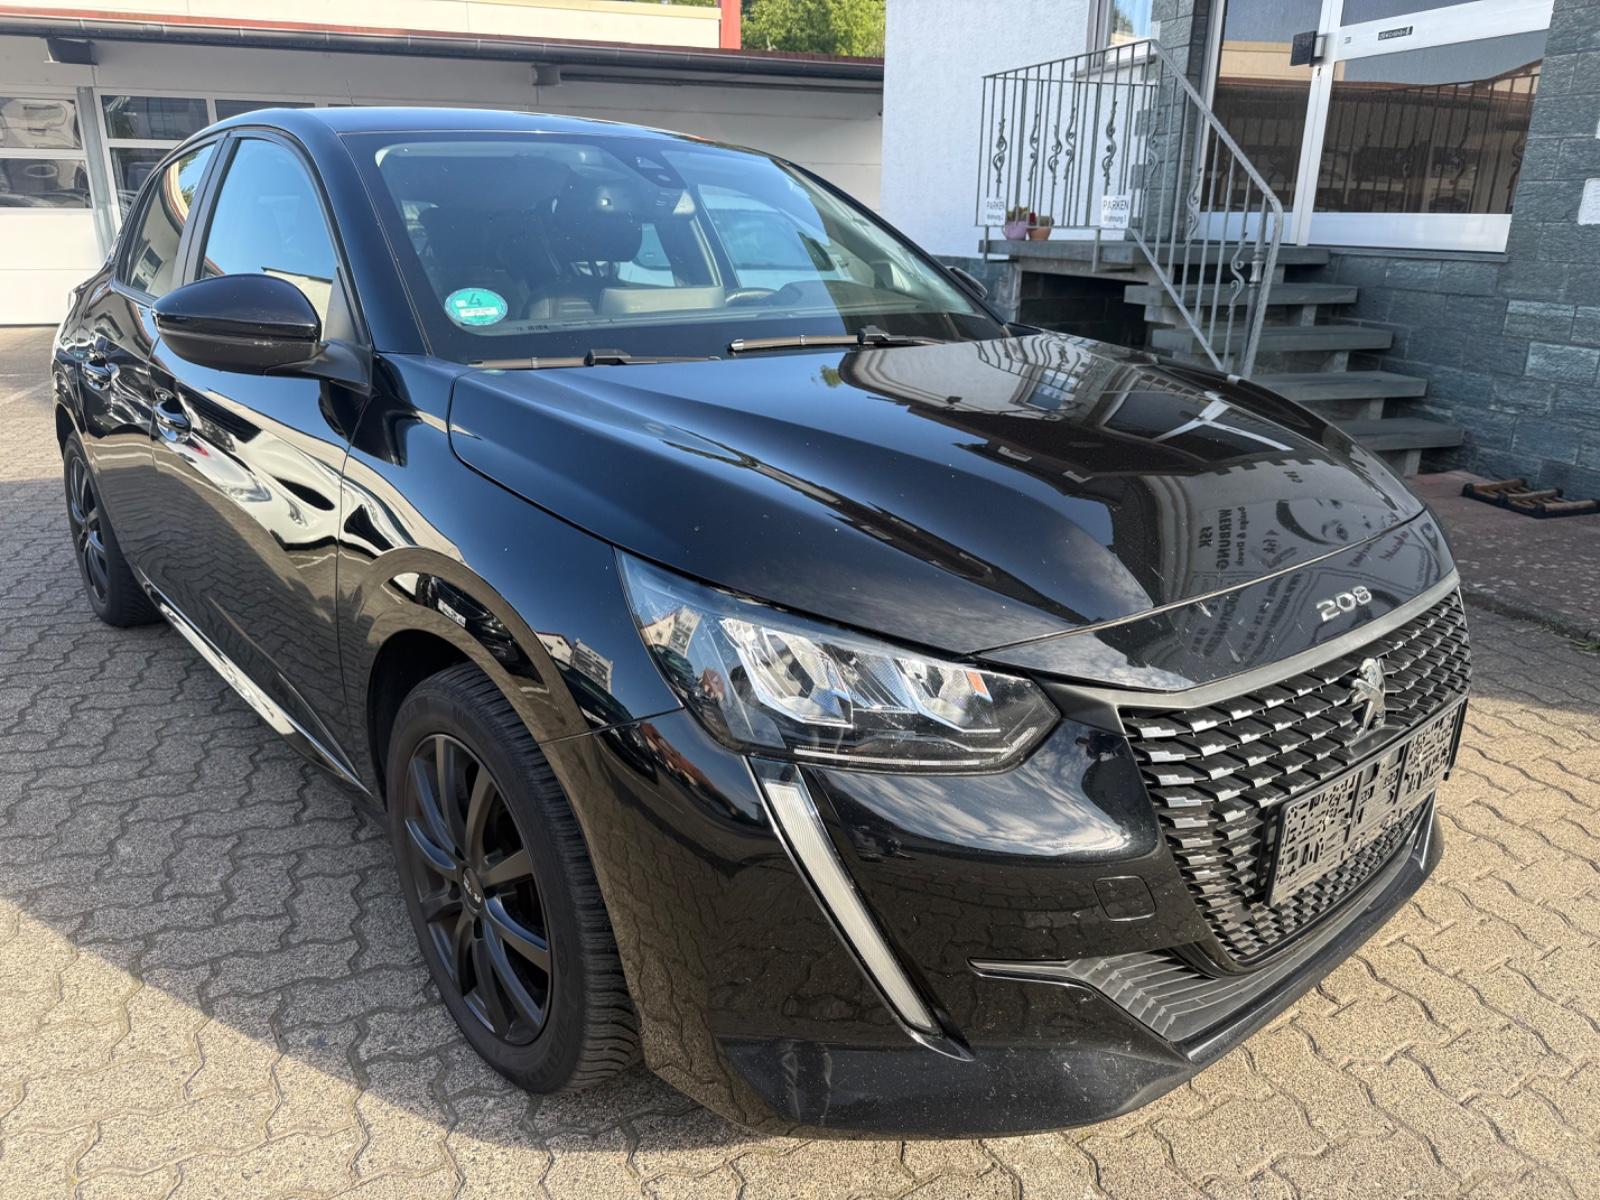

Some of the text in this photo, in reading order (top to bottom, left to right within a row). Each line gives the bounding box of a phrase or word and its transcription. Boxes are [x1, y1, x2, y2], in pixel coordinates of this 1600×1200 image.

[1102, 199, 1129, 210] PARKEN
[468, 293, 483, 306] 4
[1316, 586, 1372, 622] 208
